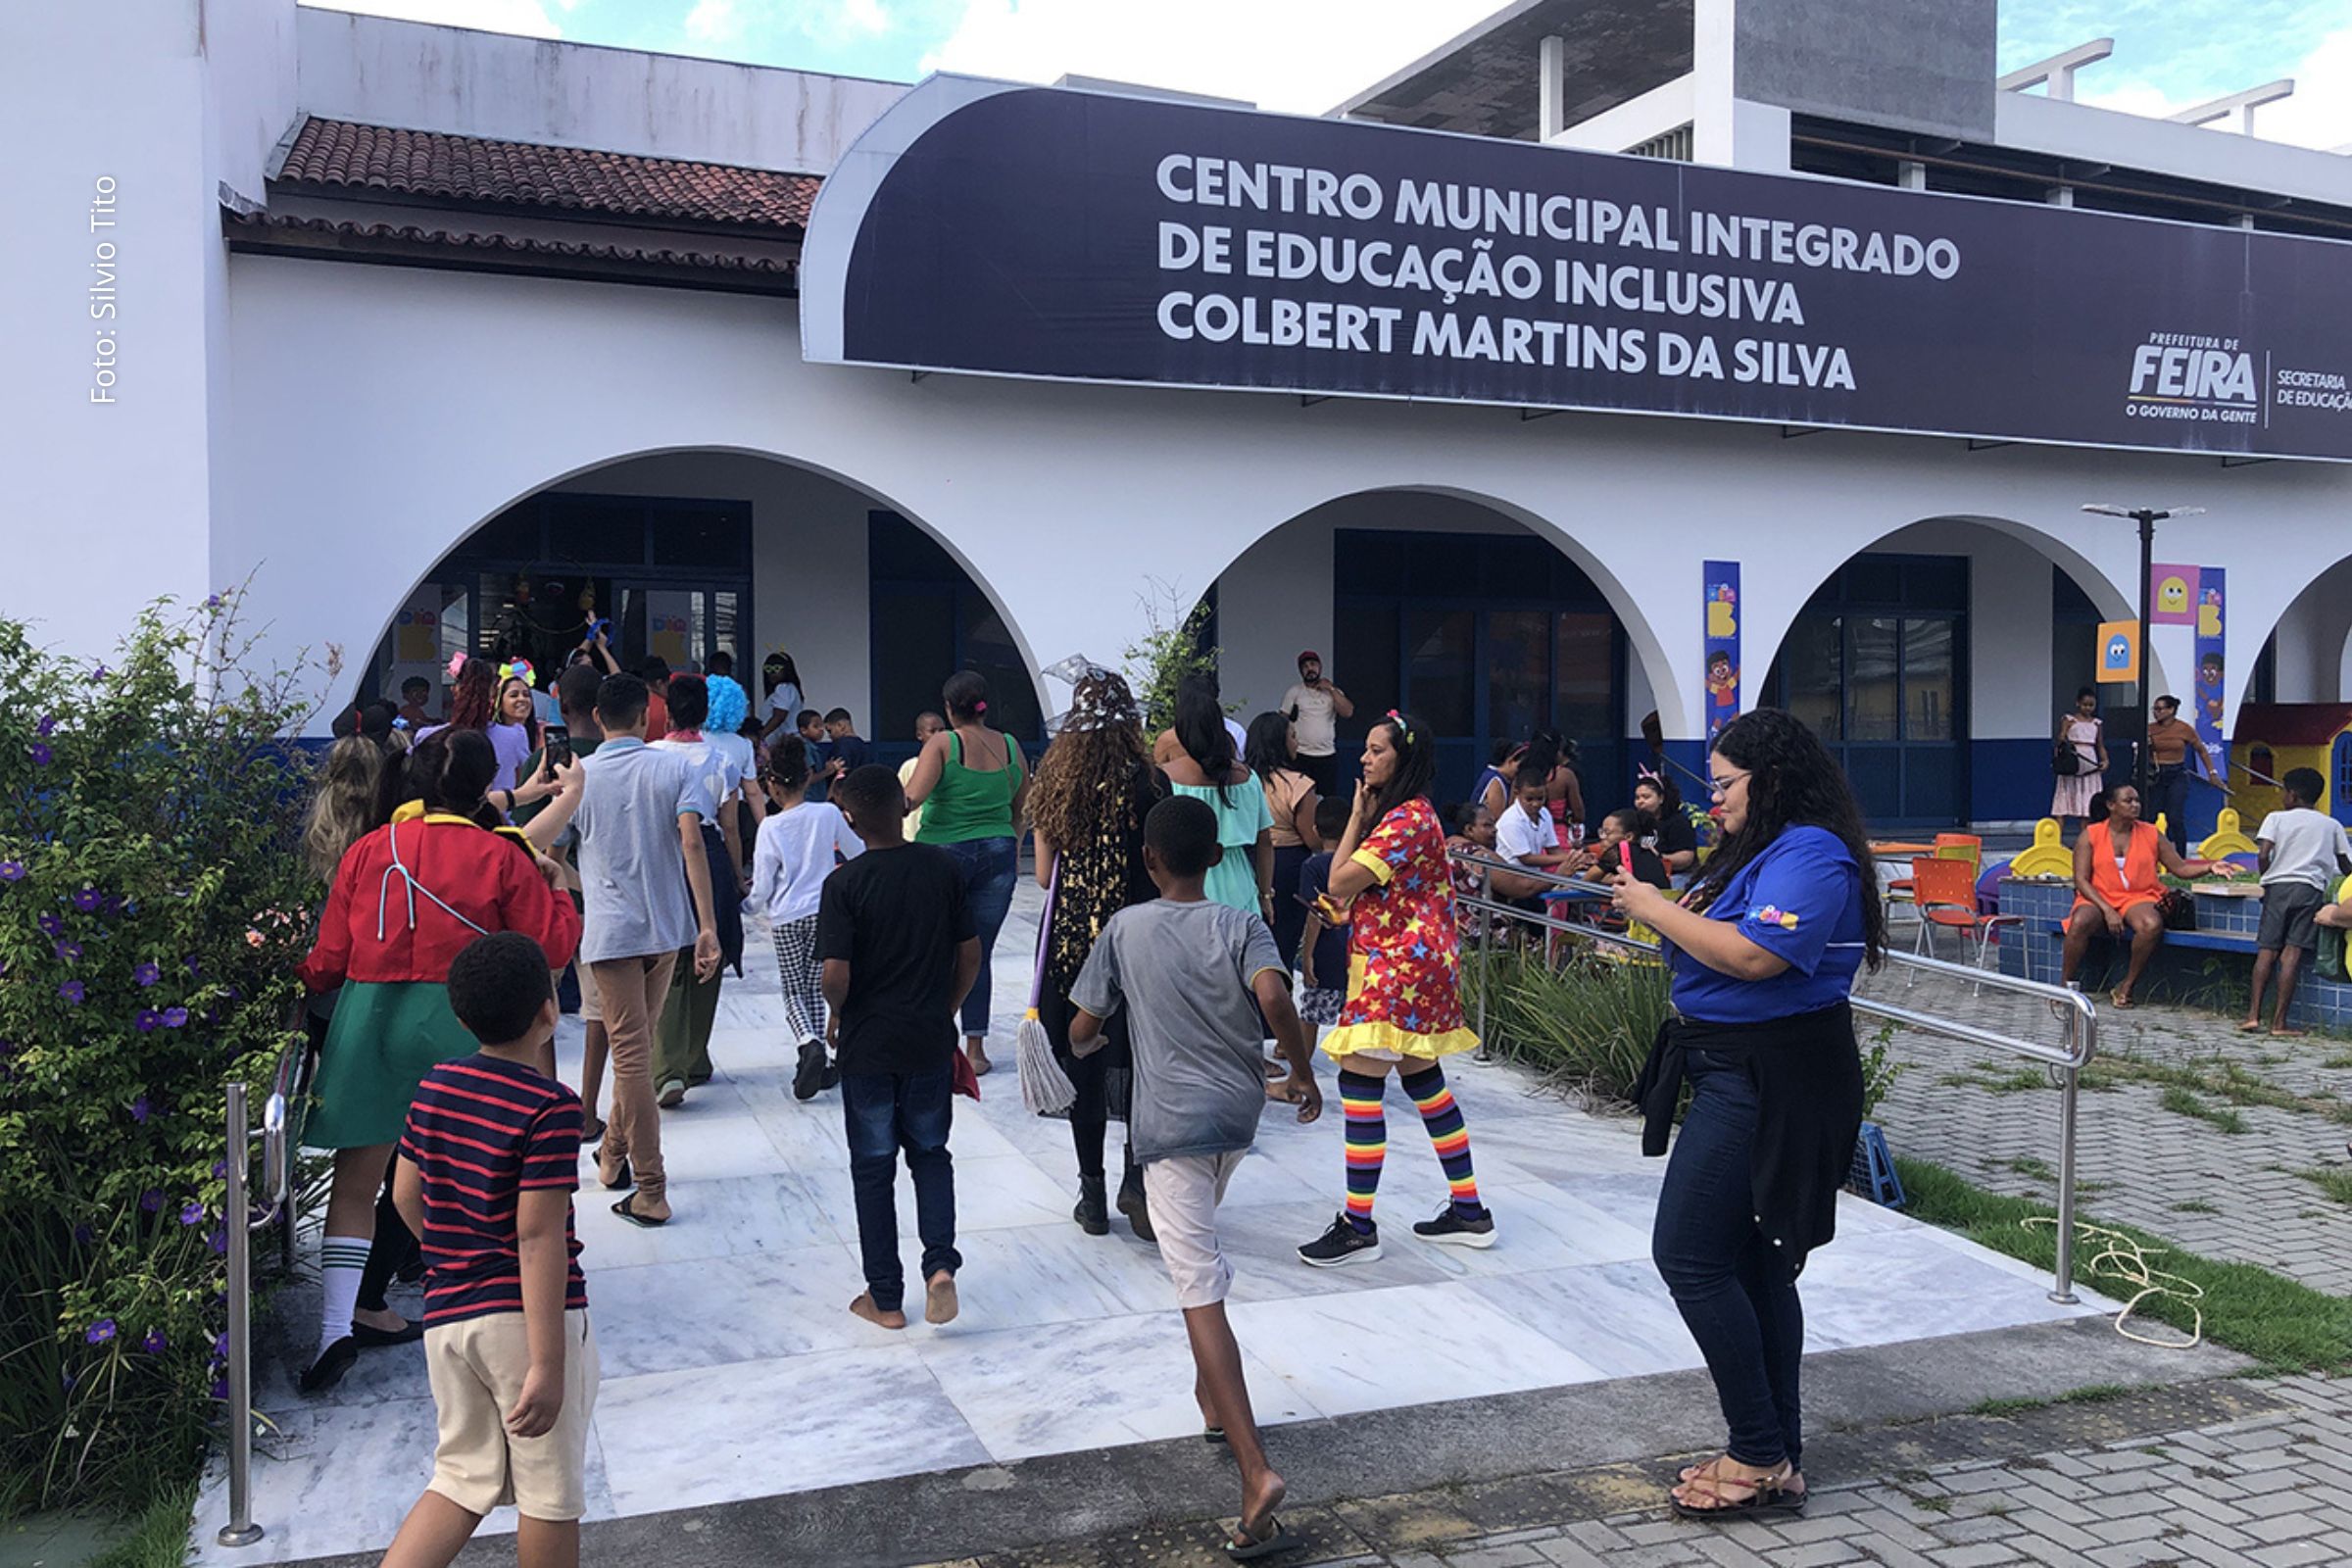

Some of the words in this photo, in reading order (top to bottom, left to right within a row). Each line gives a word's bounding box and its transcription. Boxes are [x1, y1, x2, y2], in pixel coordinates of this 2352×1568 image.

[1156, 154, 1383, 220] CENTRO
[1394, 178, 1680, 252] MUNICIPAL
[1690, 211, 1960, 279] INTEGRADO
[1158, 220, 1232, 274] DE
[1247, 229, 1543, 305] EDUCAÇÃO
[1555, 259, 1805, 325] INCLUSIVA
[1156, 291, 1402, 353] COLBERT
[1411, 311, 1647, 373] MARTINS
[1658, 332, 1725, 379] DA
[1734, 338, 1856, 390] SILVA
[2149, 332, 2220, 349] PREFEITURA
[2224, 338, 2238, 351] DE
[2130, 345, 2256, 401] FEIRA
[2277, 369, 2346, 390] SECRETARIA
[2126, 404, 2136, 416] O
[2139, 405, 2199, 419] GOVERNO
[2201, 409, 2218, 420] DA
[2221, 410, 2257, 423] GENTE
[2277, 389, 2294, 405] DE
[2295, 390, 2352, 412] EDUCAÇÃ
